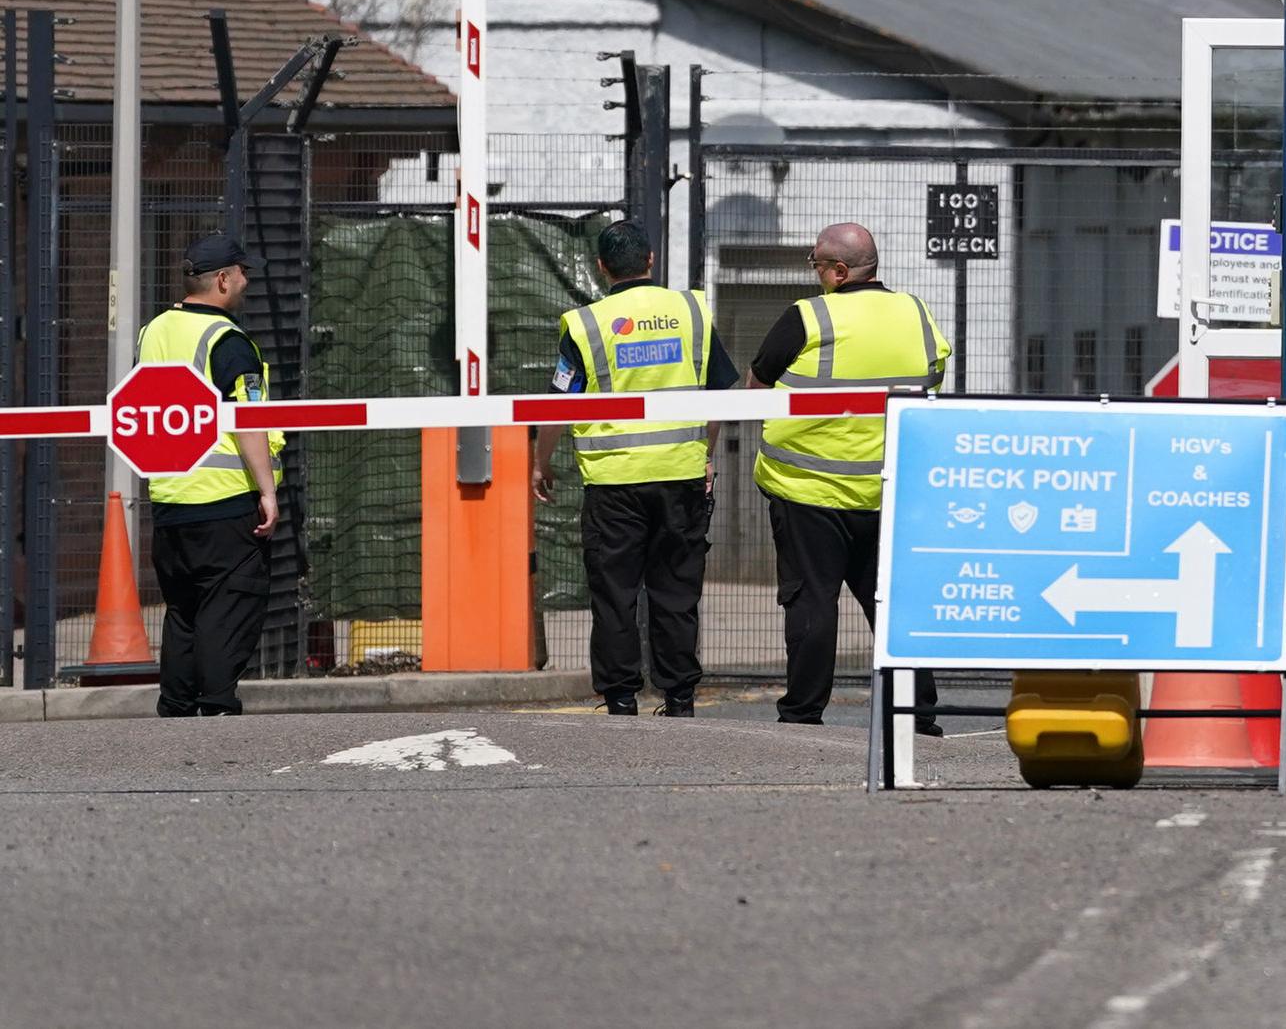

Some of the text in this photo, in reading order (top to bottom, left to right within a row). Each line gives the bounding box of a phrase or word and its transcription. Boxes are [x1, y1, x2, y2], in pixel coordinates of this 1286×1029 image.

[954, 214, 977, 229] ID
[928, 237, 996, 252] CHECK
[1210, 231, 1270, 251] OTICE
[1211, 258, 1280, 270] ployees and
[1221, 275, 1249, 283] must
[1219, 305, 1229, 313] at
[1233, 305, 1245, 314] all
[1249, 306, 1272, 315] time
[637, 314, 680, 332] mitie
[618, 341, 680, 365] SECURITY
[115, 404, 215, 437] STOP
[955, 432, 1094, 457] SECURITY
[1170, 436, 1233, 455] HGV's
[928, 466, 1118, 492] CHECK POINT
[1192, 464, 1209, 481] &
[1147, 490, 1250, 508] COACHES
[958, 562, 999, 579] ALL
[941, 583, 1014, 600] OTHER
[933, 604, 1021, 622] TRAFFIC
